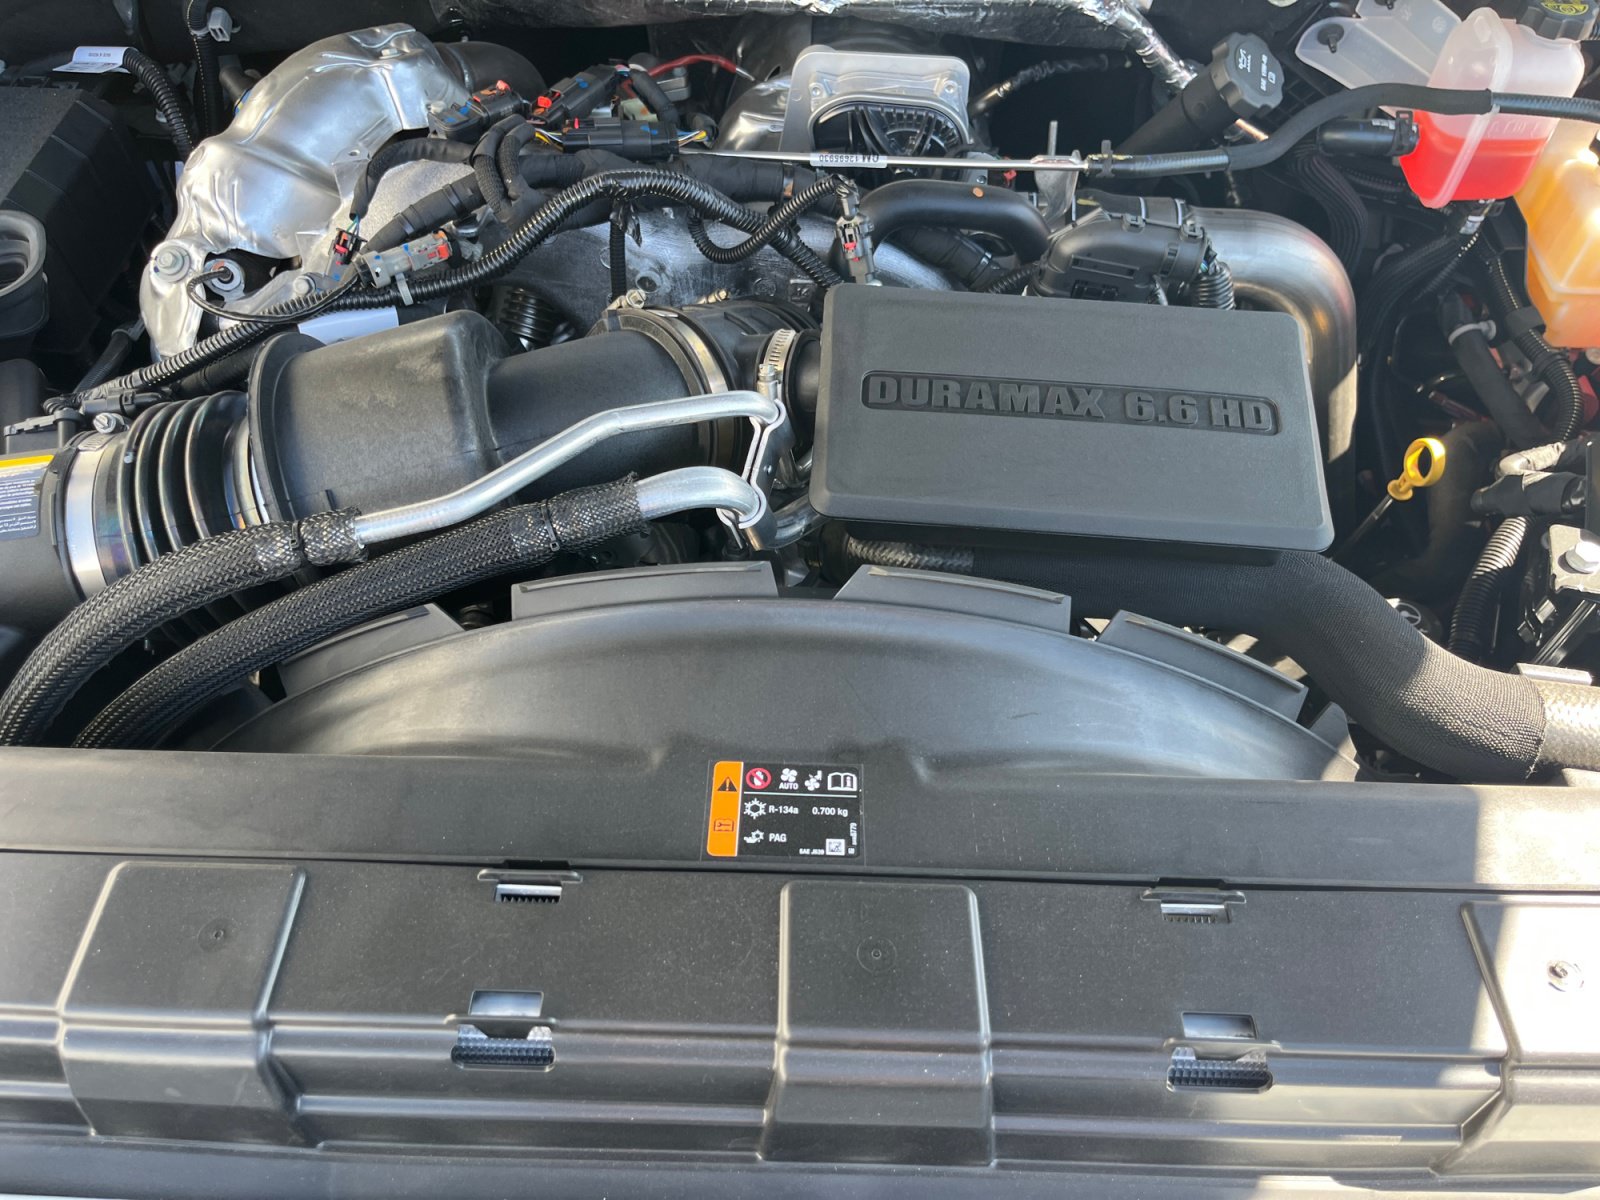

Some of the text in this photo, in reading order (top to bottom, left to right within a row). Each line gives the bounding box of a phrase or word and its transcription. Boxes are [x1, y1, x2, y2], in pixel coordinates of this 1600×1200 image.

[868, 375, 1273, 430] DURAMAX 6.6 HD
[768, 805, 848, 817] R-134a 0.700 kg
[768, 833, 787, 842] PAG
